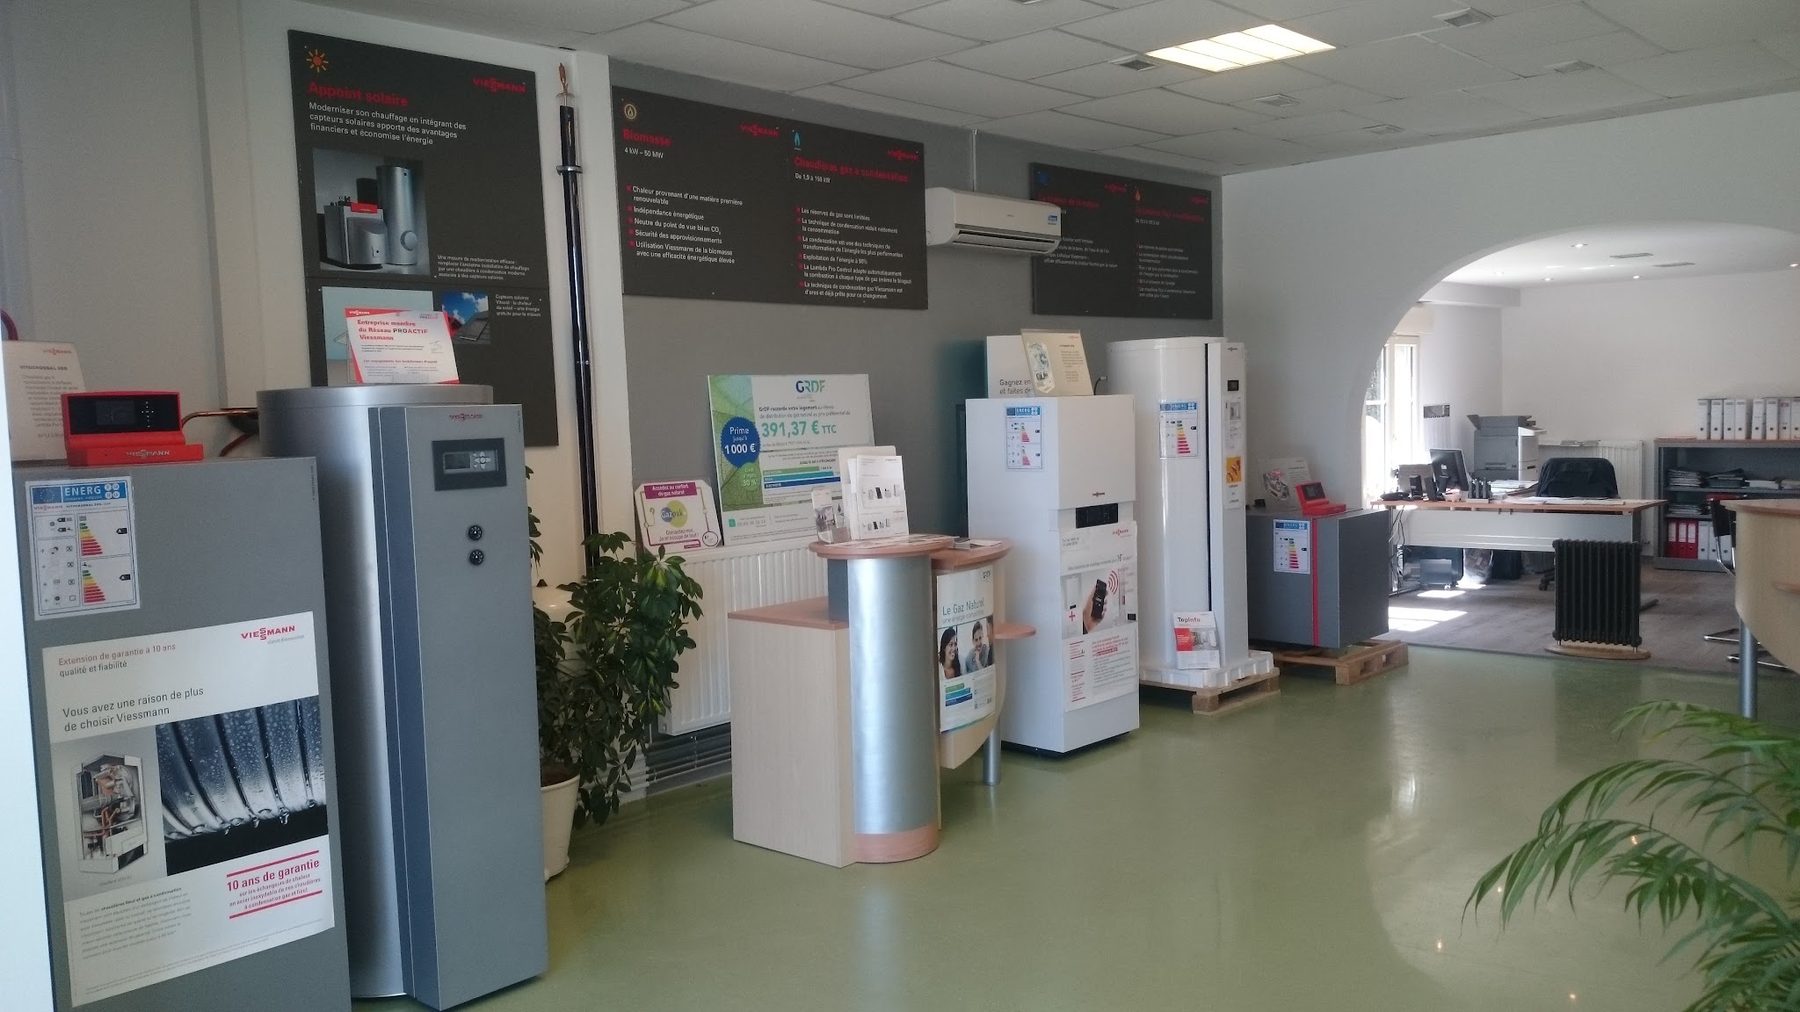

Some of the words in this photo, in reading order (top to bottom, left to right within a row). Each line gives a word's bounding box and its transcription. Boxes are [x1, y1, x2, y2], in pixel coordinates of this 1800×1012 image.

[307, 81, 361, 100] Appoint
[366, 90, 408, 106] solaire
[309, 102, 353, 114] Moderniser
[356, 109, 370, 117] son
[371, 109, 407, 123] chauffage
[410, 116, 418, 124] en
[421, 116, 452, 129] intégrant
[454, 121, 466, 130] des
[310, 114, 343, 125] capteurs
[345, 117, 374, 128] solaires
[377, 121, 405, 134] apporte
[407, 124, 419, 134] des
[422, 127, 457, 140] avantages
[310, 123, 348, 134] financiers
[350, 127, 357, 135] et
[360, 128, 400, 141] économise
[402, 132, 433, 145] l'énergie
[623, 128, 671, 146] Biomasse
[652, 151, 664, 159] MW
[632, 186, 654, 194] Chaleur
[656, 189, 682, 199] provenant
[634, 195, 668, 205] renouvelable
[634, 206, 672, 216] Indépendance
[673, 210, 704, 220] énergétique
[634, 218, 653, 226] Neutre
[655, 219, 661, 227] du
[663, 220, 677, 229] point
[697, 224, 710, 232] bilan
[635, 229, 658, 238] Sécurité
[659, 231, 668, 239] des
[670, 233, 722, 244] approvisionnements
[636, 241, 663, 250] Utilisation
[665, 244, 694, 252] Viessmann
[709, 248, 732, 256] biomasse
[662, 252, 686, 260] efficacité
[687, 254, 717, 263] énergétique
[796, 380, 825, 393] GRDF
[1000, 379, 1022, 387] Gagnez
[730, 426, 749, 435] Prime
[761, 421, 807, 438] 391,37
[811, 420, 819, 434] €
[822, 425, 837, 434] TTC
[750, 444, 756, 453] €
[64, 486, 101, 496] ENERG
[943, 606, 951, 616] Le
[954, 604, 964, 614] Gaz
[966, 597, 984, 610] Naturel
[241, 625, 295, 642] VIESSMANN
[58, 654, 98, 666] Extension
[100, 652, 110, 661] de
[111, 648, 144, 661] garantie
[146, 646, 151, 654] à
[153, 644, 161, 652] 10
[163, 643, 176, 652] ans
[59, 665, 87, 678] qualité
[89, 664, 97, 673] et
[99, 660, 127, 671] fiabilité
[62, 705, 89, 718] Vous
[92, 701, 115, 713] avez
[117, 698, 135, 709] une
[138, 693, 168, 705] raison
[170, 690, 182, 700] de
[184, 686, 204, 699] plus
[64, 721, 77, 732] de
[80, 714, 114, 730] choisir
[117, 706, 170, 724] Viessmann
[227, 880, 239, 891] 10
[242, 876, 260, 888] ans
[263, 872, 275, 882] de
[278, 859, 319, 879] garantie
[257, 881, 285, 892] échangeurs
[293, 873, 310, 882] chaleur
[251, 890, 277, 902] inoxydable
